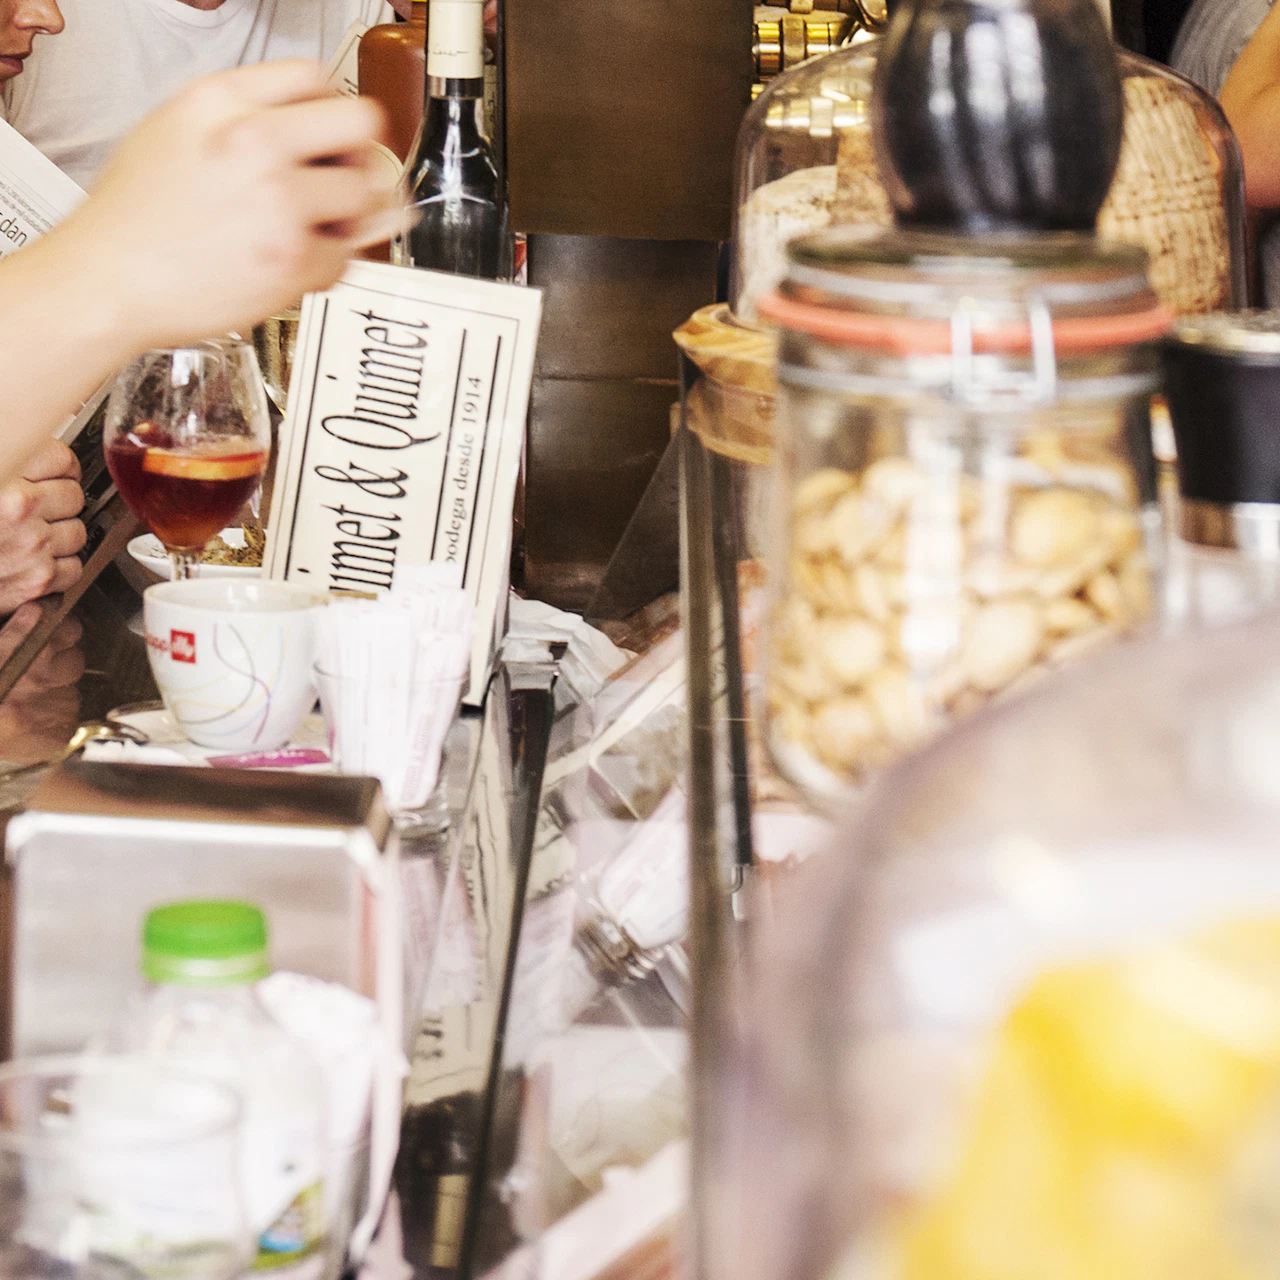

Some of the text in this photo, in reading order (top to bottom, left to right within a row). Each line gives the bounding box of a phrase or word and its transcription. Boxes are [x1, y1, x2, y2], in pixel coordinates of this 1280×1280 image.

[0, 217, 28, 248] dan
[462, 375, 482, 425] 1914
[297, 308, 442, 593] imet & Quimet
[457, 432, 476, 491] desde
[172, 634, 195, 658] illy
